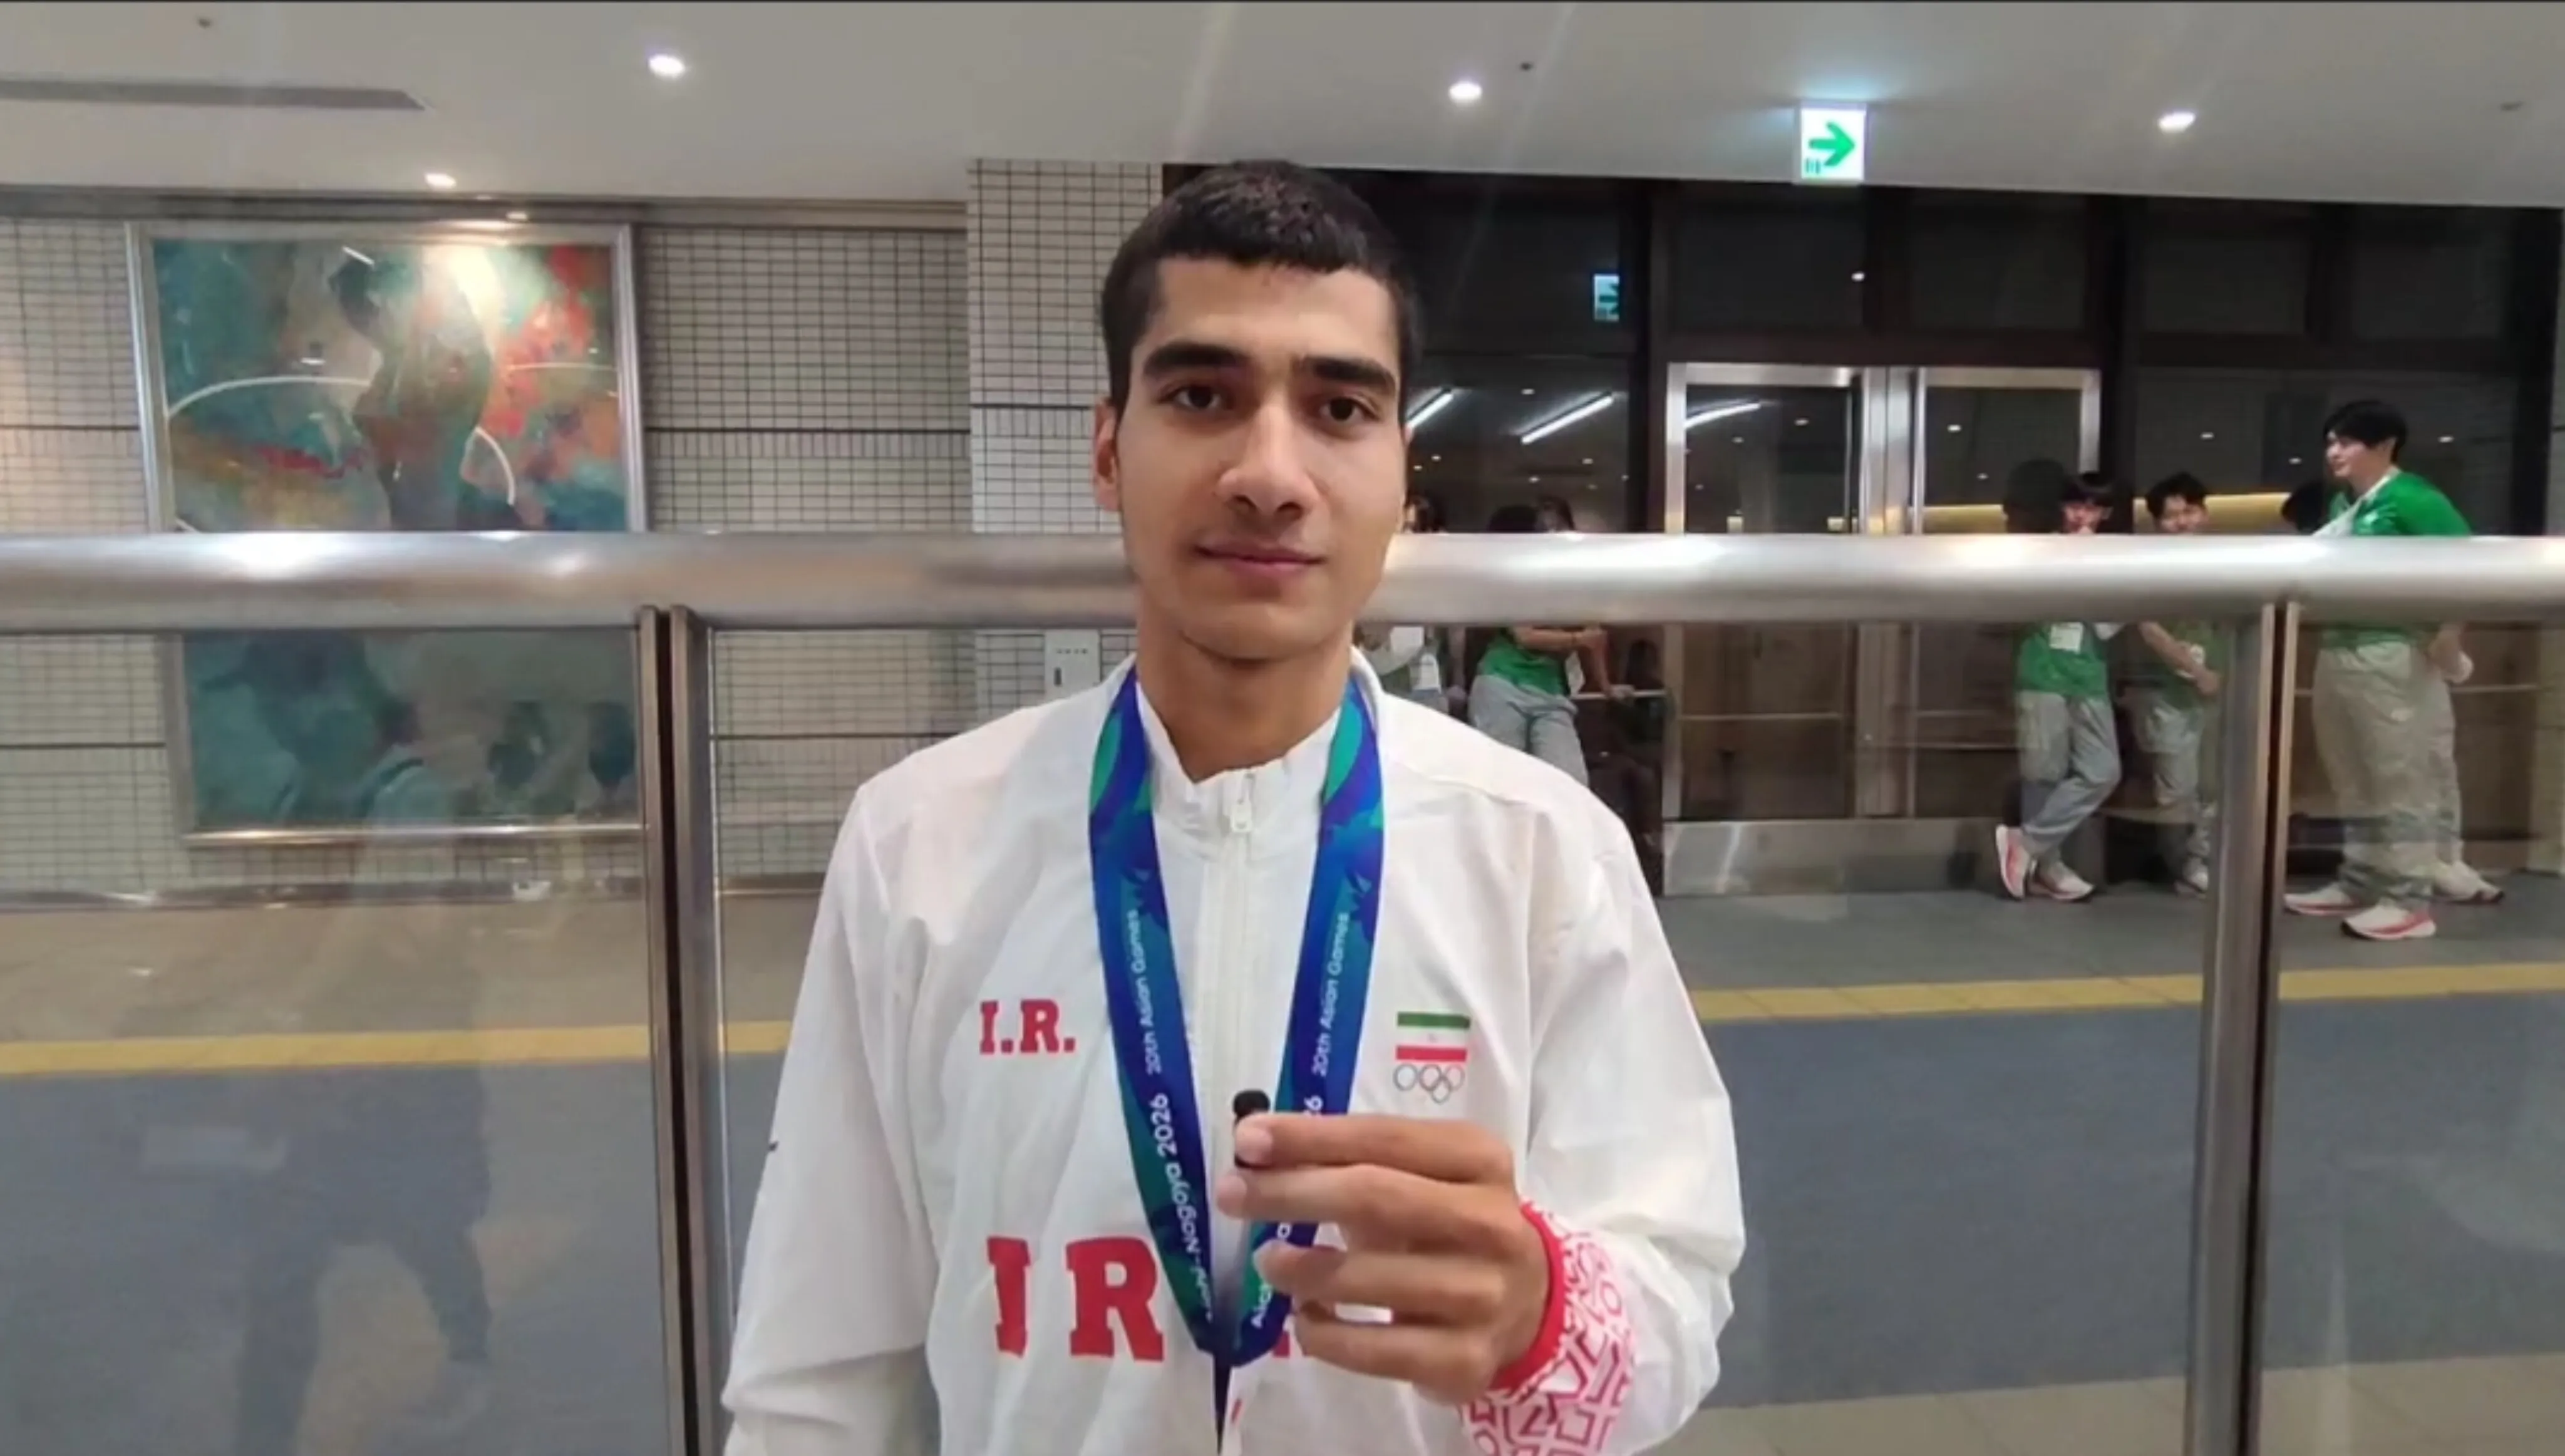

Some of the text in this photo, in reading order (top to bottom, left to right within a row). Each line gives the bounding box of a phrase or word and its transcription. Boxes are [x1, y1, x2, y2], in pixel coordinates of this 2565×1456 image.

[1327, 912, 1350, 976] Games
[1128, 910, 1162, 1075] 20th Asian Games
[1319, 979, 1339, 1030] Asian
[980, 999, 1076, 1055] I.R.
[1311, 1033, 1332, 1077] 20th
[1150, 1094, 1177, 1157] 2026
